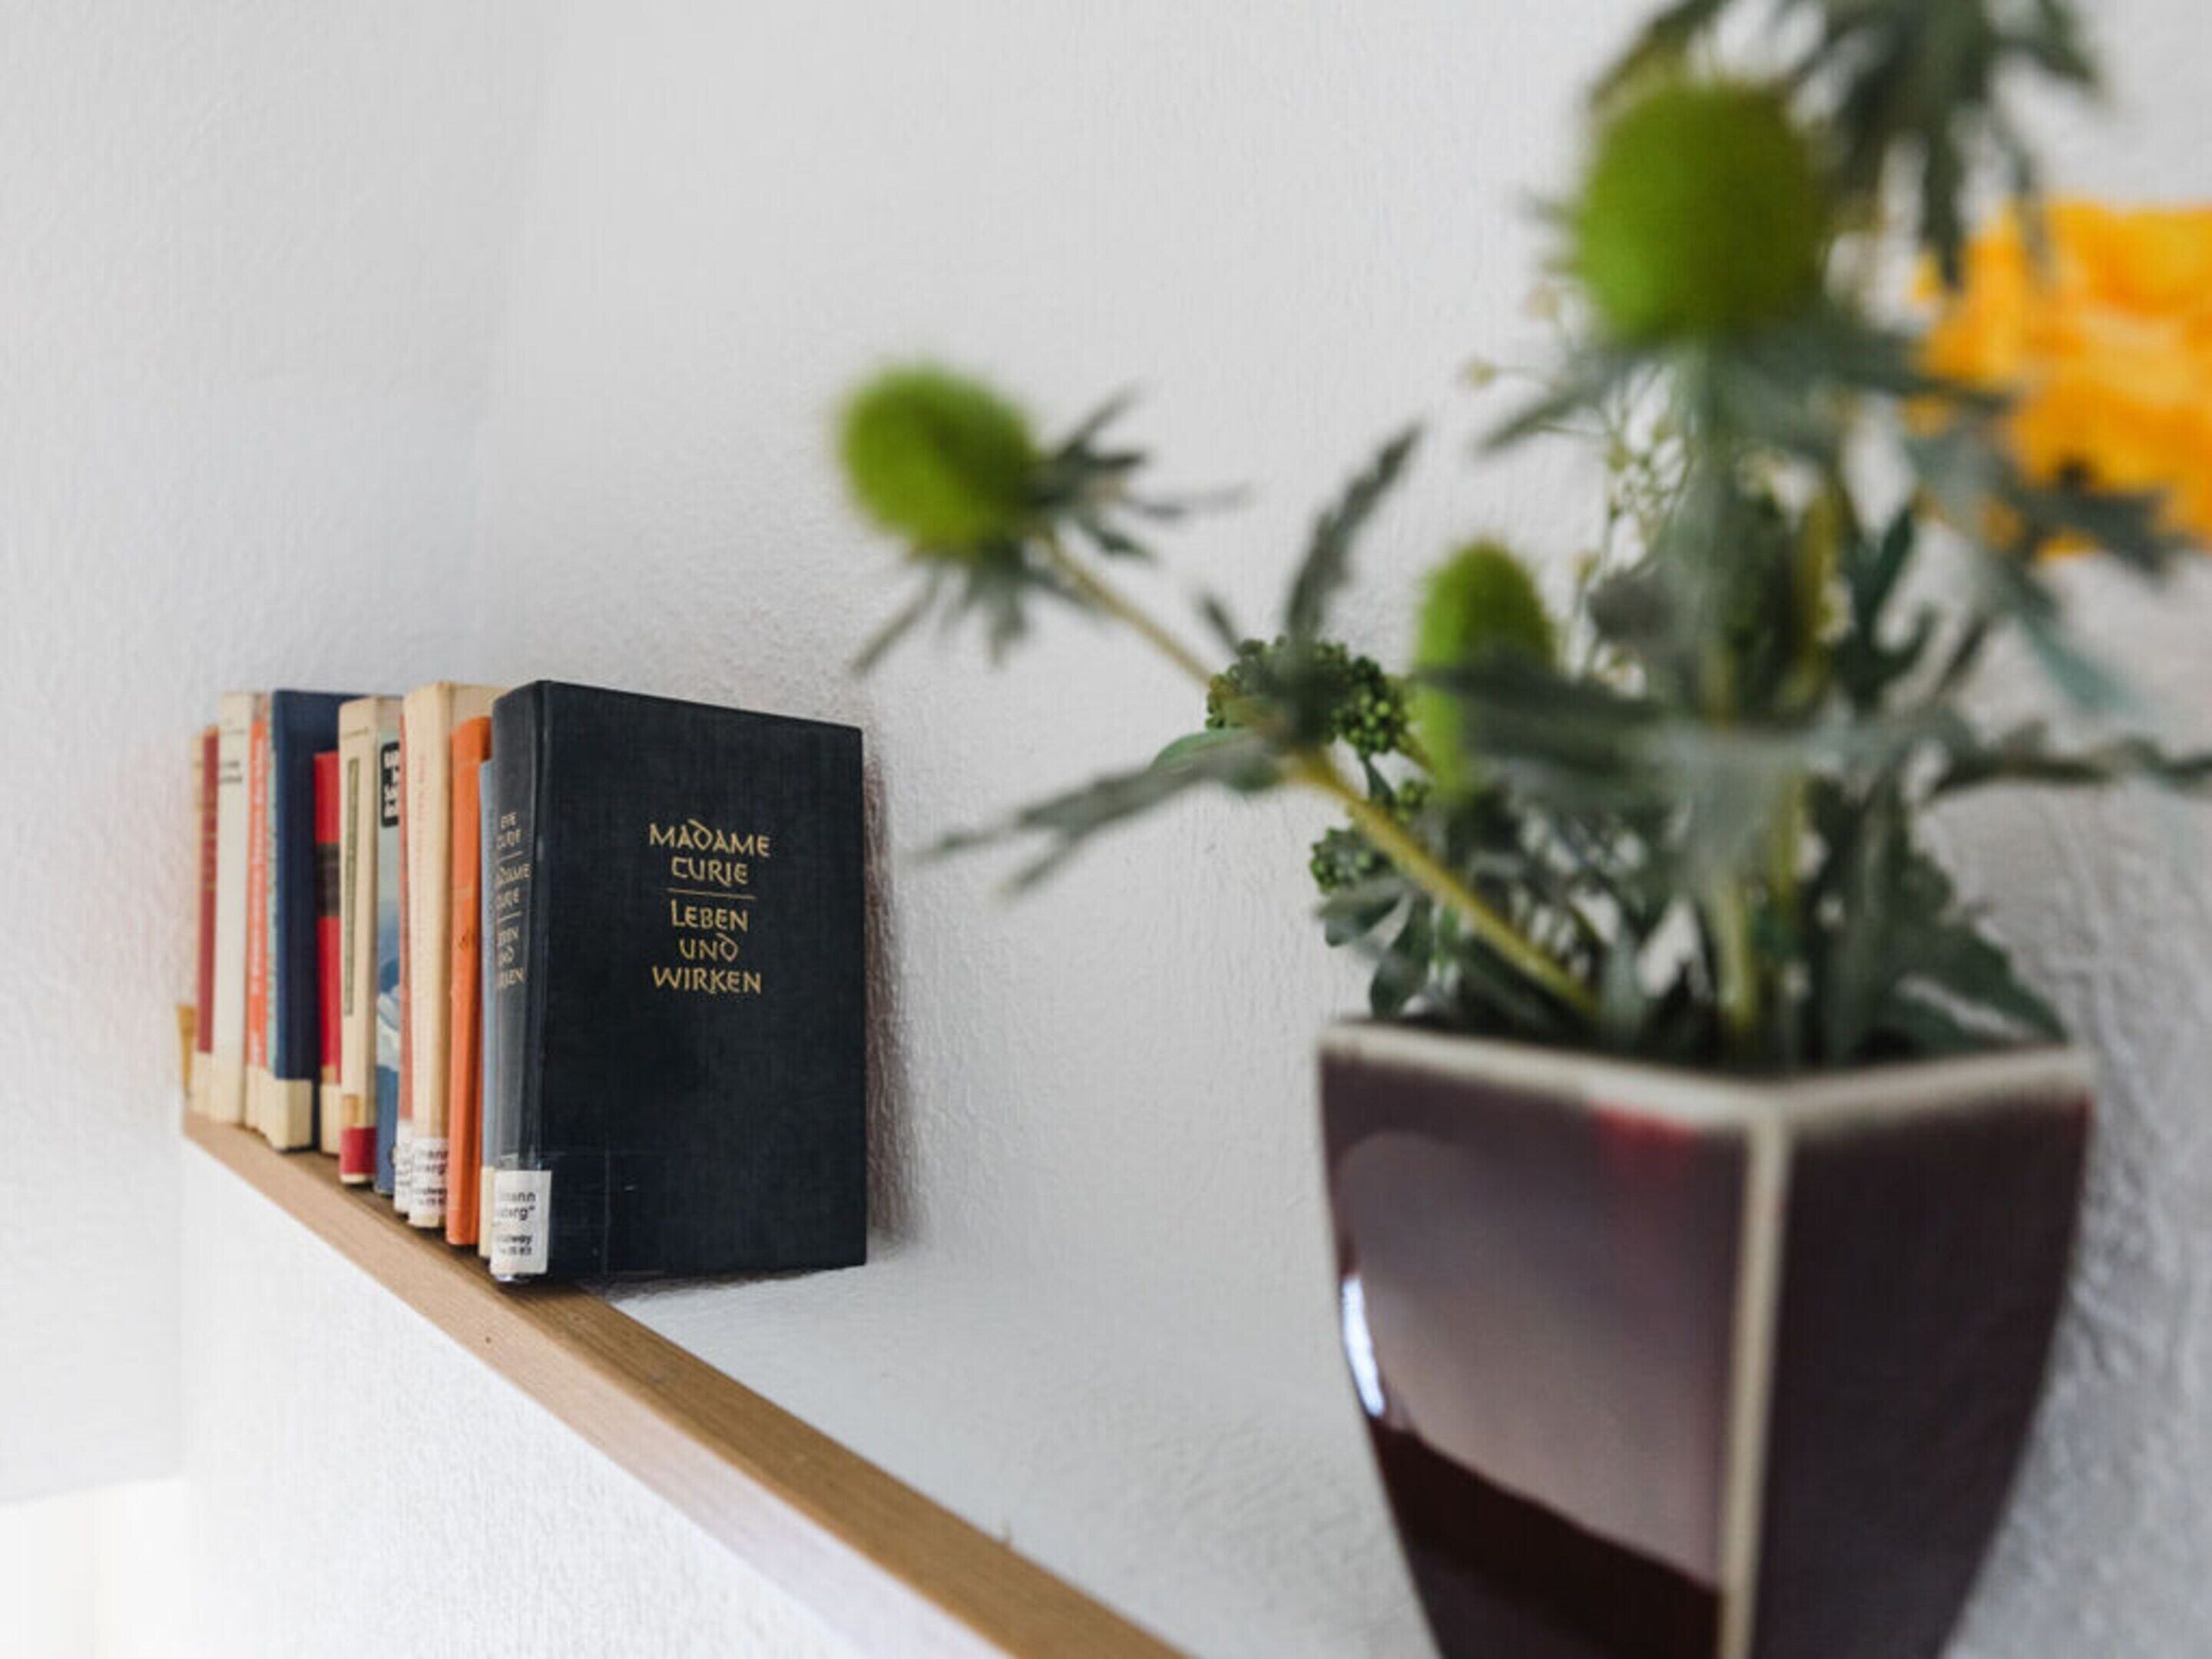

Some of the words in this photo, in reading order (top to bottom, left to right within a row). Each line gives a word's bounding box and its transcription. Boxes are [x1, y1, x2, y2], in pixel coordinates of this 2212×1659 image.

[650, 818, 770, 858] MADAME
[671, 856, 749, 886] CURIE
[671, 899, 748, 932] LEBEN
[680, 932, 739, 962] UND
[653, 965, 761, 994] WIRKEN
